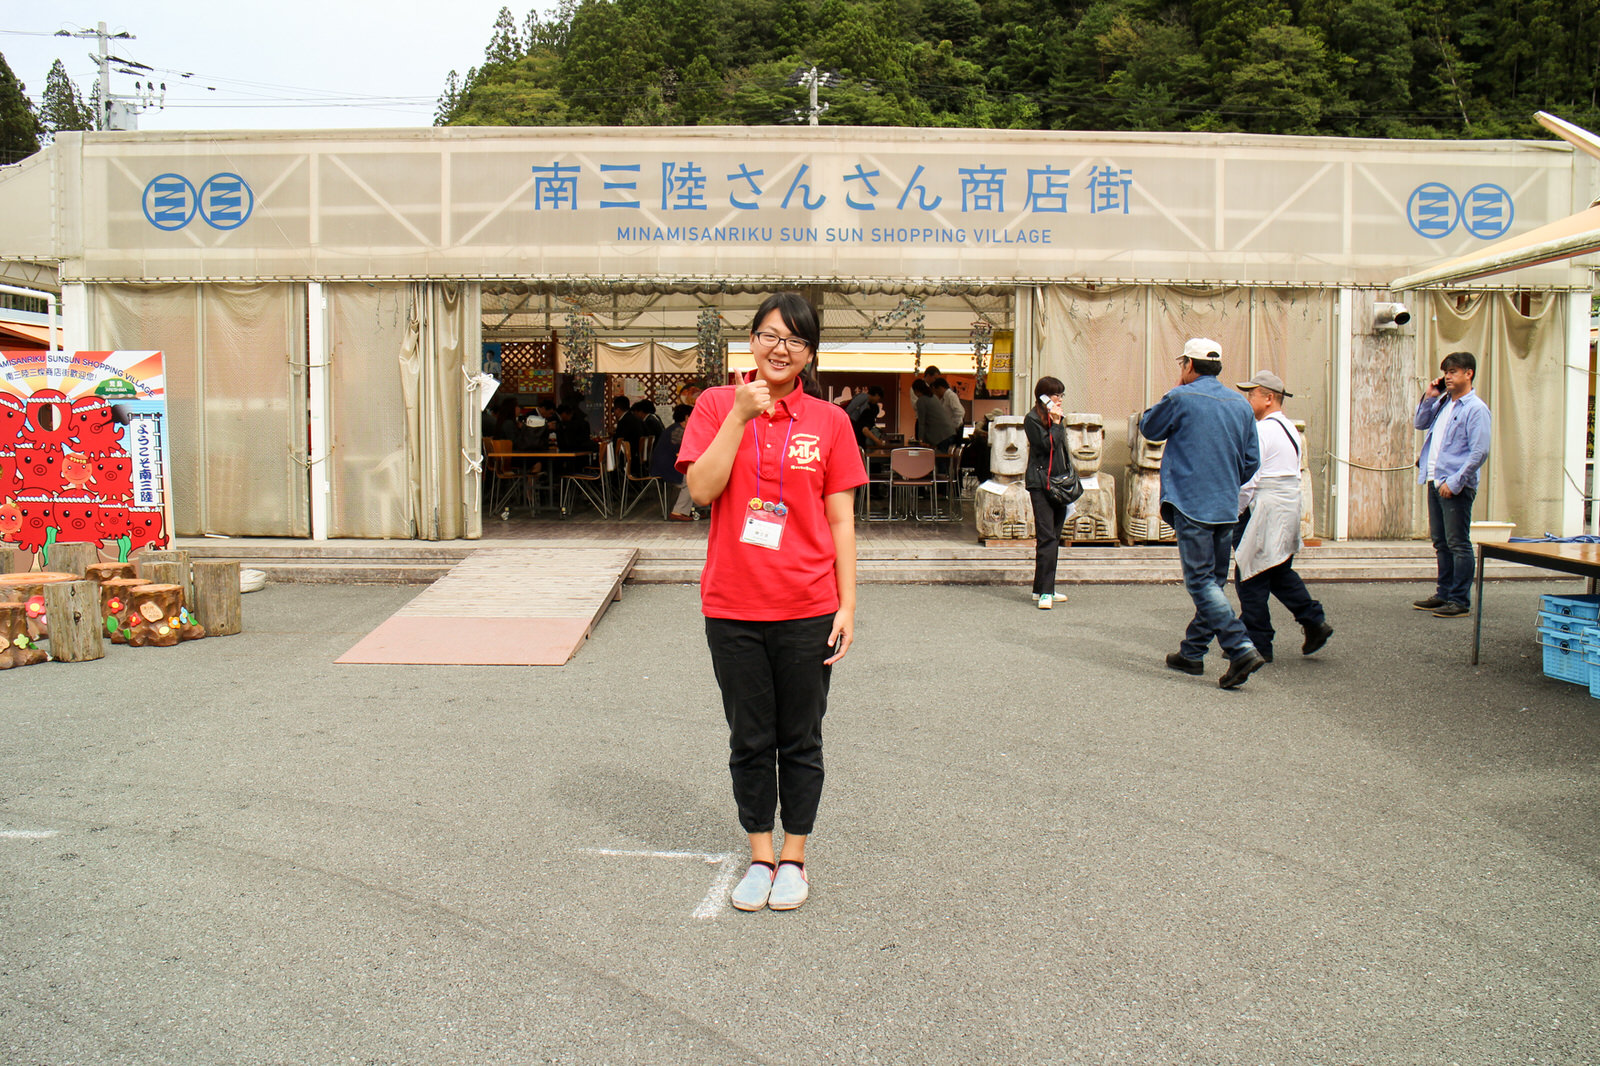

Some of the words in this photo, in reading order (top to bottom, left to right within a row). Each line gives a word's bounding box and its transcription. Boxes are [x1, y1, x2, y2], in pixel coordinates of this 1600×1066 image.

[531, 161, 1133, 215] 南三陸さんさん商店街
[618, 226, 772, 242] MINAMISANRIKU
[781, 227, 817, 242] SUN
[827, 228, 863, 242] SUN
[872, 228, 965, 243] SHOPPING
[974, 229, 1051, 244] VILLAGE
[48, 355, 81, 364] SUNSUN
[82, 358, 124, 377] SHOPPING
[125, 372, 156, 398] VILLAGE
[137, 423, 154, 503] ようこそ南三陸
